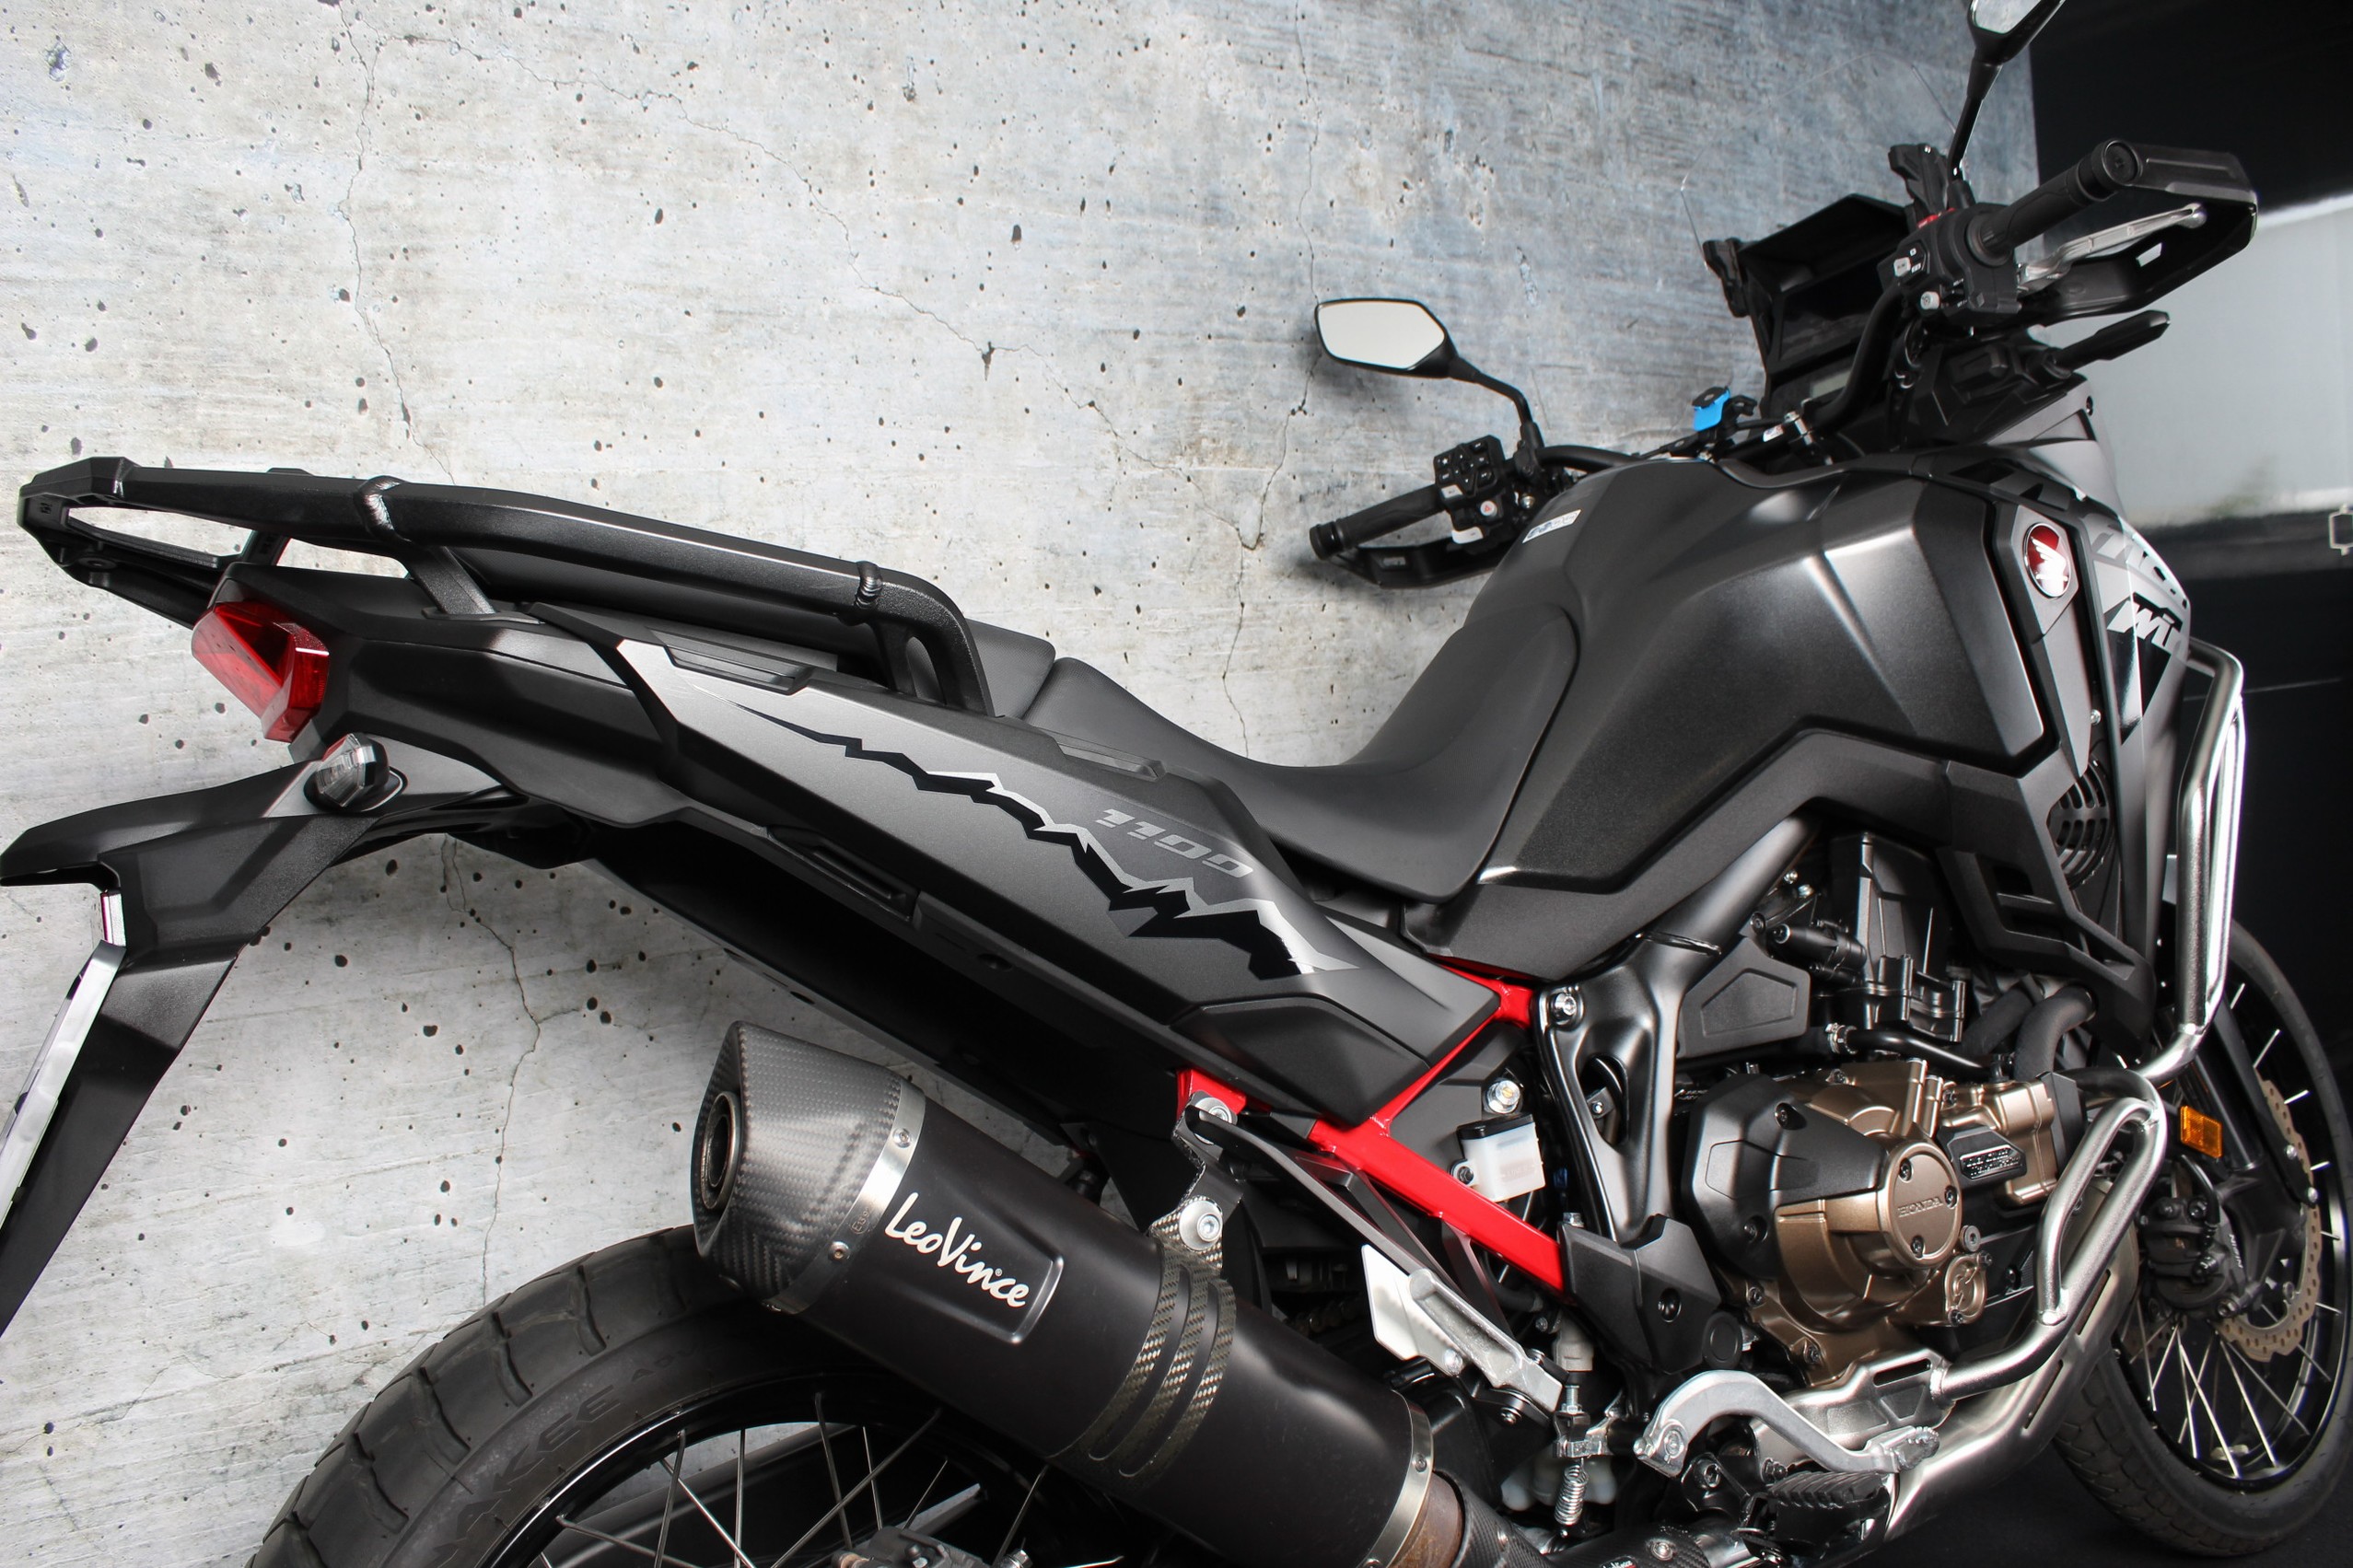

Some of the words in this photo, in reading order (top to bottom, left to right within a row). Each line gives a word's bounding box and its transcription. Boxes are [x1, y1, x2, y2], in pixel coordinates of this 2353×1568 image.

[1095, 808, 1254, 878] 1100
[1898, 1196, 1944, 1218] HONDA
[884, 1191, 1030, 1308] LeoVince
